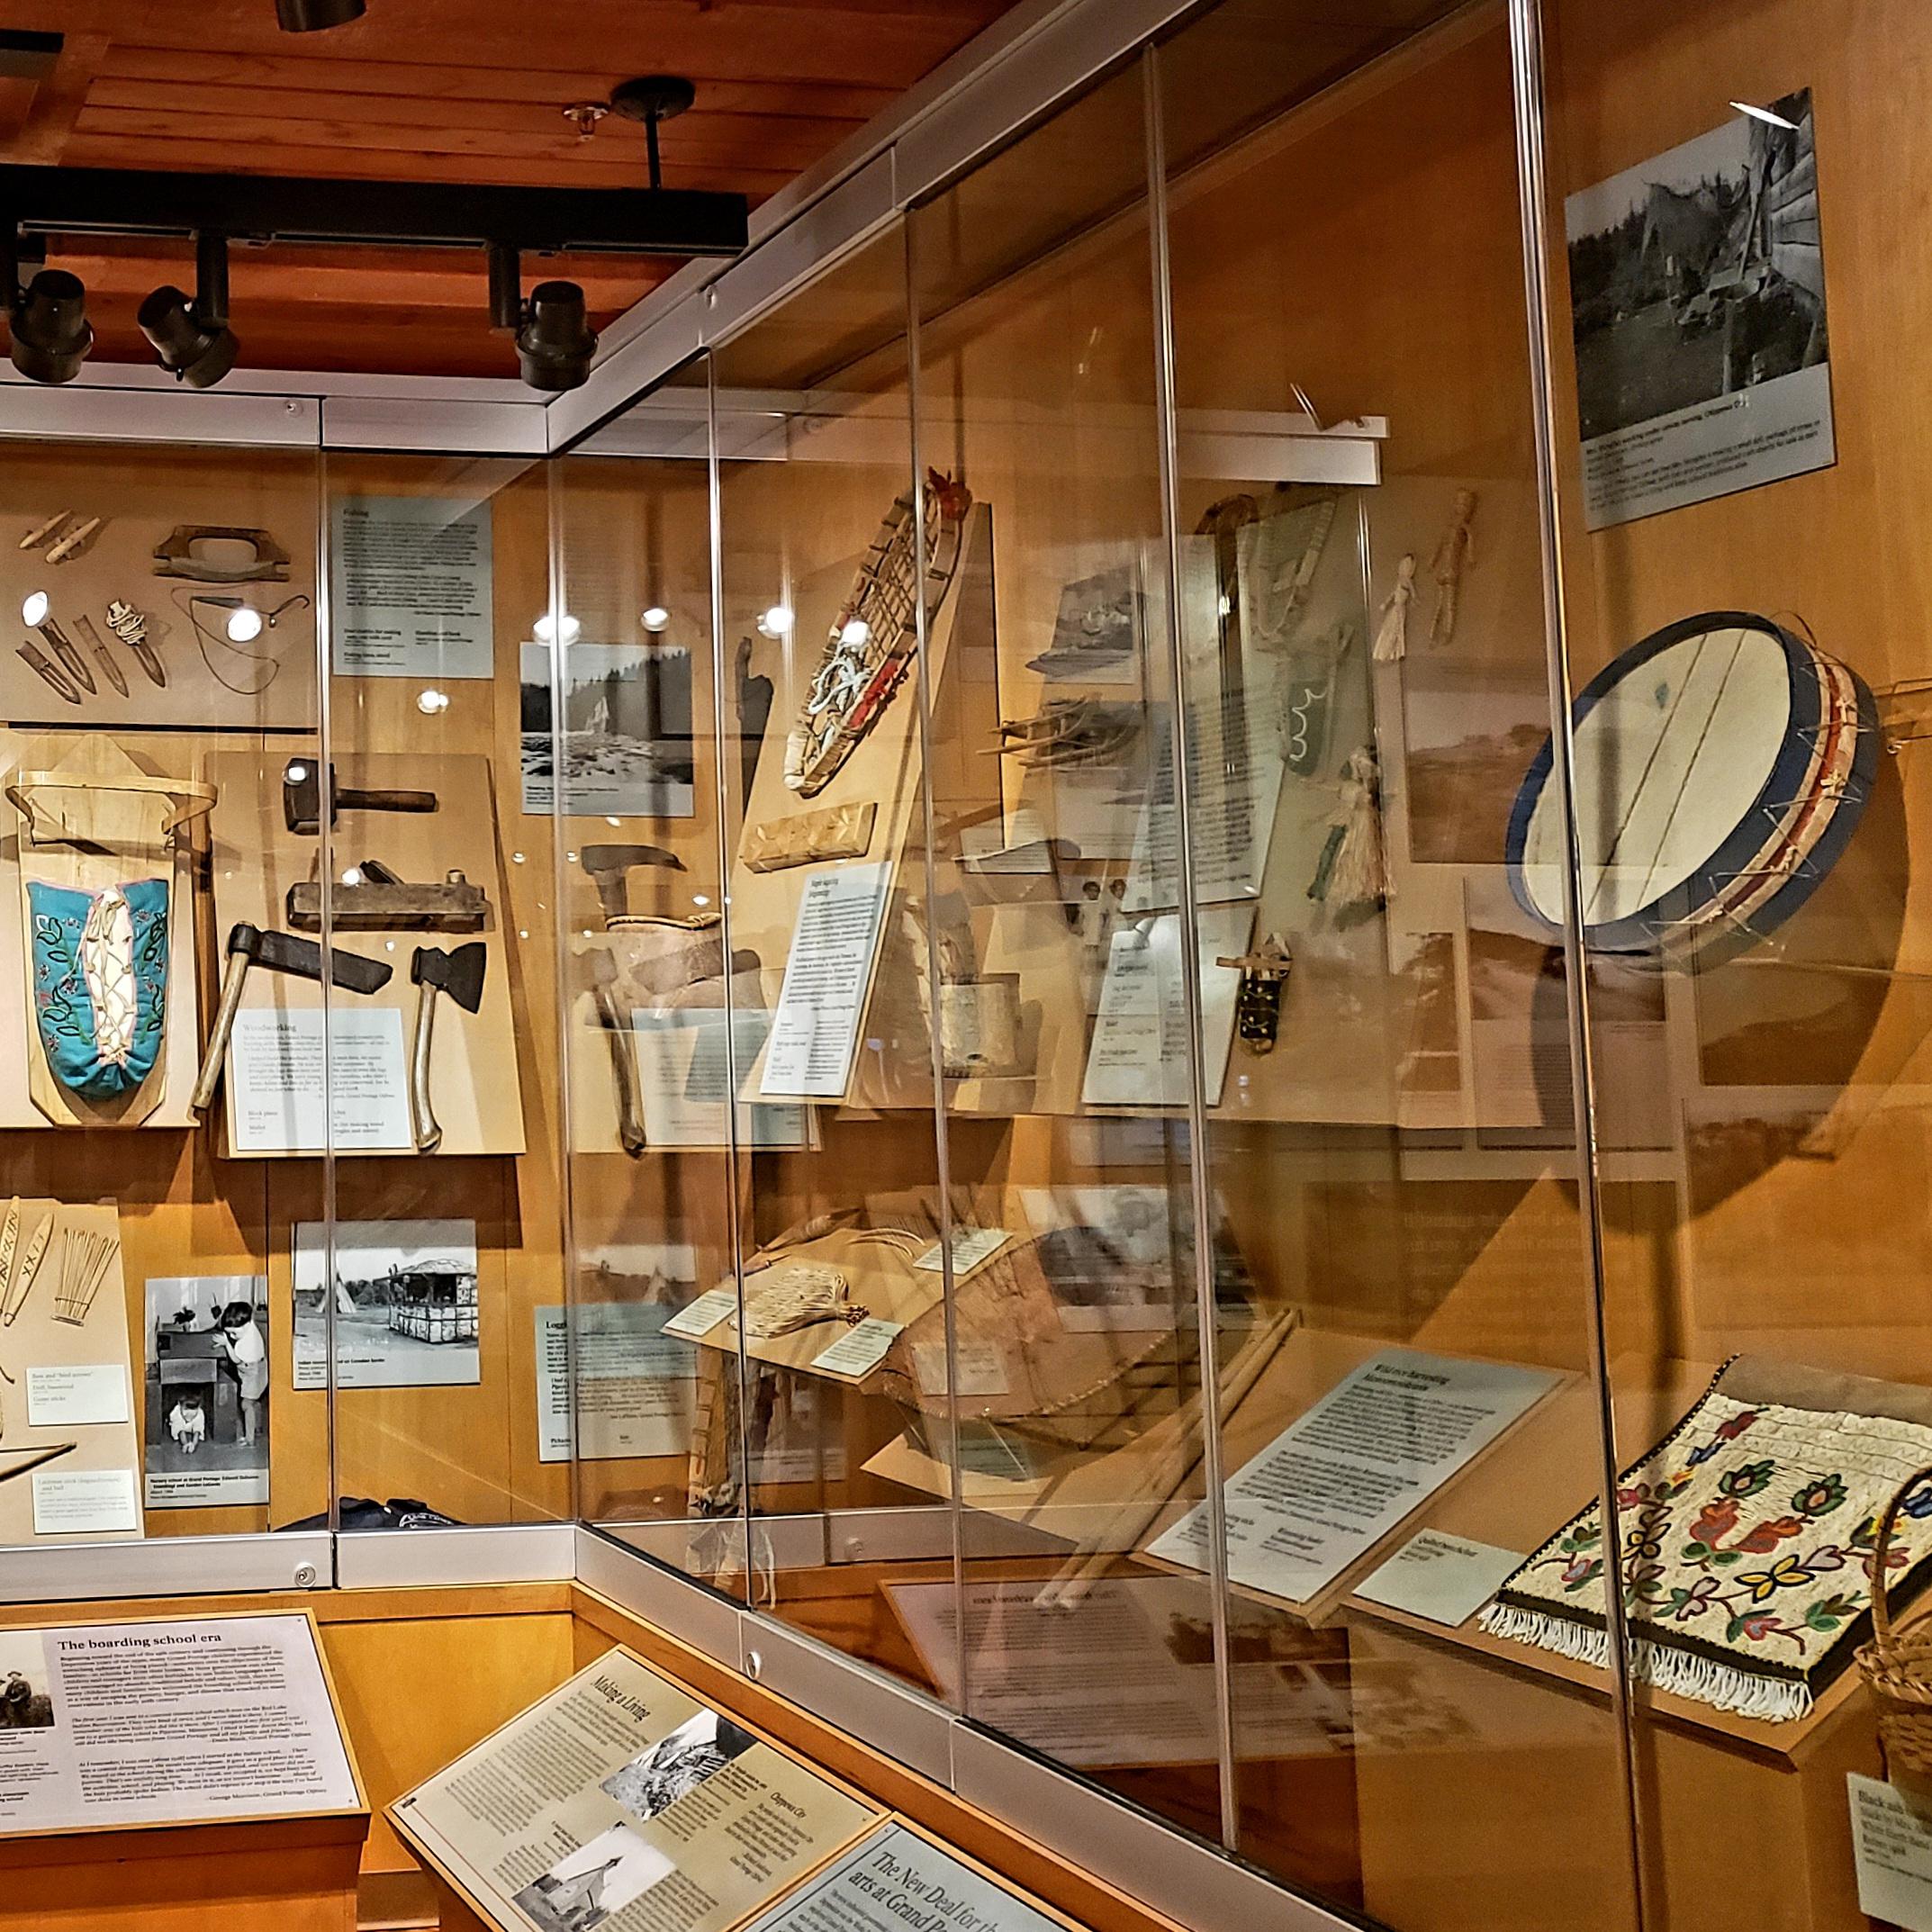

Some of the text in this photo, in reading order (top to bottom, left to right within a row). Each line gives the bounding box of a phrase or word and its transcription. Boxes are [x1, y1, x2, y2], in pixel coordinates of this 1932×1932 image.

[58, 1634, 222, 1651] The boarding school era
[591, 1675, 622, 1703] Making
[621, 1696, 651, 1723] Living
[848, 1872, 878, 1893] arts
[871, 1886, 891, 1902] at
[886, 1893, 935, 1930] Grand
[871, 1851, 900, 1878] The
[894, 1866, 931, 1895] New
[924, 1885, 965, 1917] Deal
[952, 1907, 982, 1931] for
